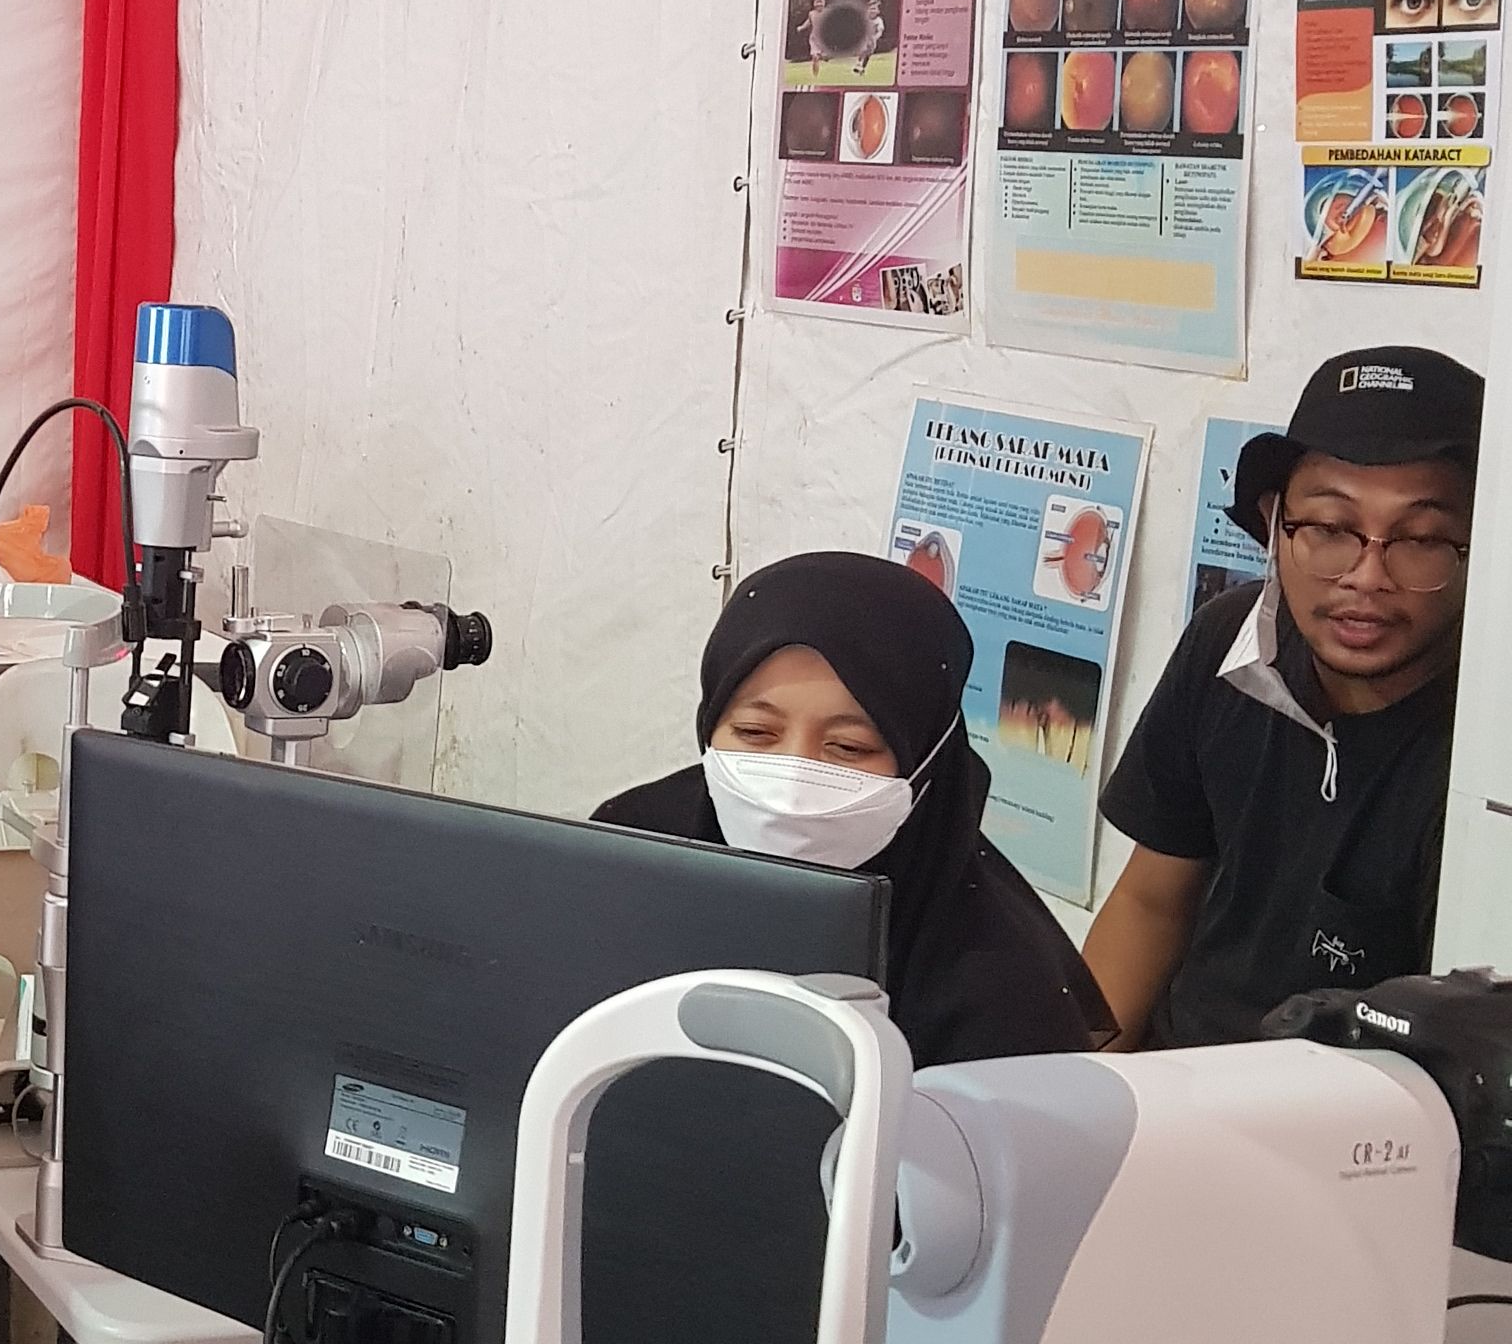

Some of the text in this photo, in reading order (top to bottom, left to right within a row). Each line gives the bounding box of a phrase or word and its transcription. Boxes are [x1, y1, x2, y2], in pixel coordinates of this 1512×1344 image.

[1327, 148, 1463, 162] PEMBEDAHAN KATARACT
[1361, 365, 1403, 376] NATIONAL
[1358, 380, 1399, 390] CHANNEL
[1359, 373, 1415, 384] GEOGRAPHIC
[926, 421, 1110, 473] LEKANG SARAF MATA
[1356, 1002, 1410, 1035] Canon
[1353, 1139, 1393, 1165] CR-2
